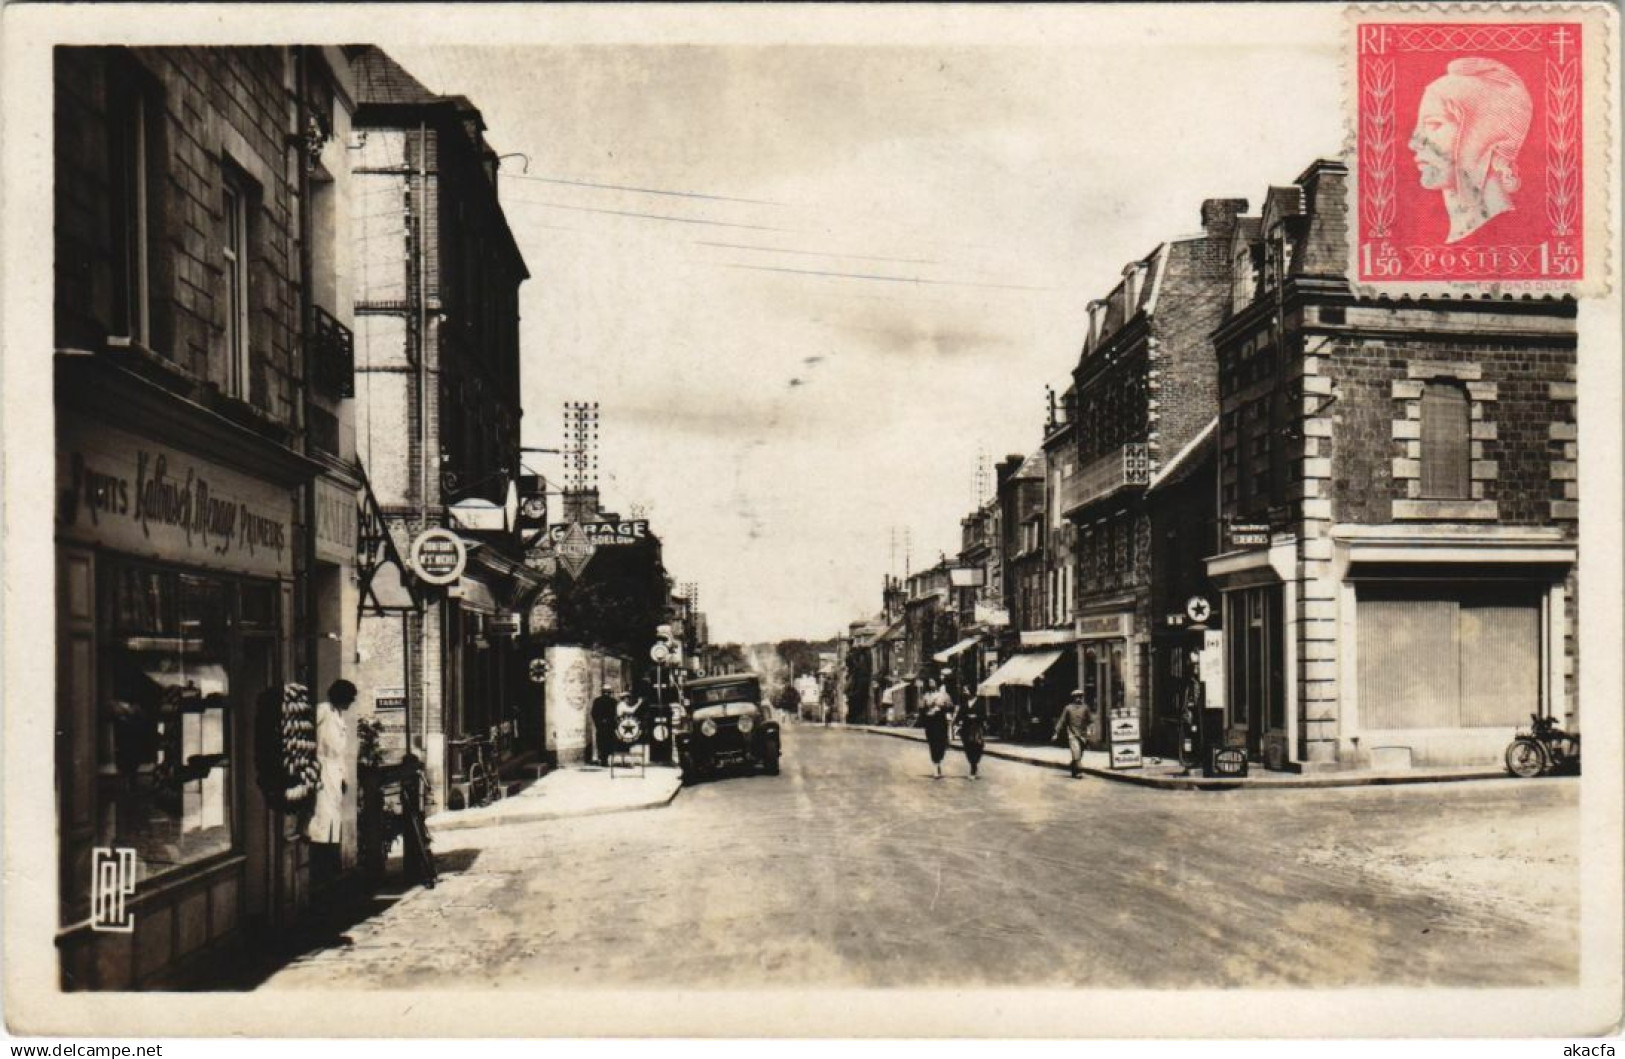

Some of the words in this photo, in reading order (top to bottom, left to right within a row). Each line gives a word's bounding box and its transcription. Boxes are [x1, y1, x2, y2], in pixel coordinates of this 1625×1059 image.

[1361, 26, 1392, 54] RF
[1425, 253, 1518, 267] POSTES
[551, 521, 645, 541] GRAGE
